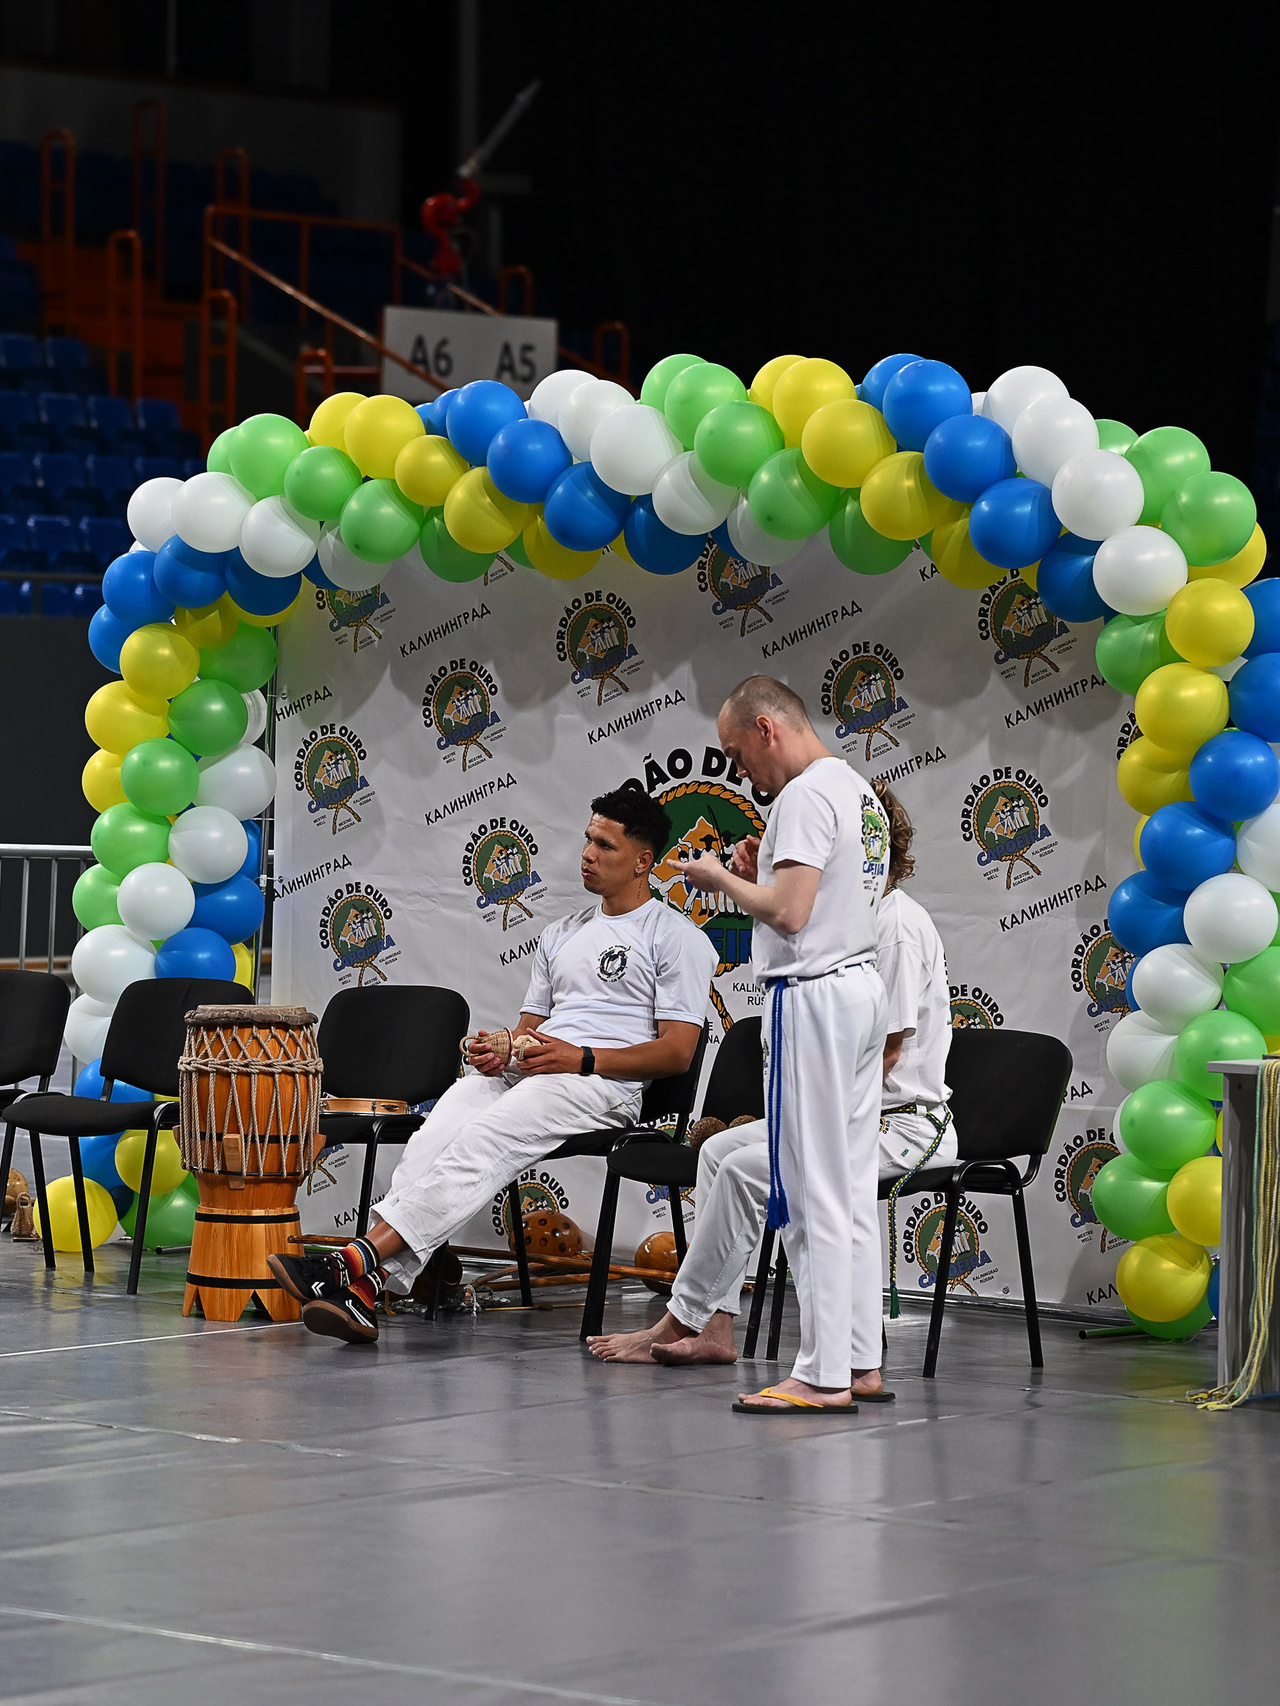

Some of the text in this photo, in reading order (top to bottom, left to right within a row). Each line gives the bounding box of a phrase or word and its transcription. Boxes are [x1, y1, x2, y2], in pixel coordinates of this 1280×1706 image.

[584, 590, 602, 602] DE
[606, 592, 636, 628] OURO
[400, 602, 491, 658] КАЛИНИНГРАД
[762, 600, 862, 659] КАЛИНИНГРАД
[450, 658, 466, 672] DE
[469, 660, 498, 696] OURO
[852, 641, 870, 654] DE
[874, 643, 904, 681] OURO
[436, 710, 501, 750] CAPOEIRA
[587, 689, 686, 745] КАЛИНИНГРАД
[835, 696, 909, 738] CAPOEIRA
[320, 724, 336, 734] DE
[339, 726, 367, 760] OURO
[308, 776, 370, 813] CAPOEIRA
[425, 772, 517, 826] КАЛИНИНГРАД
[993, 766, 1012, 780] DE
[1015, 768, 1048, 808] OURO
[490, 816, 506, 830] DE
[509, 820, 538, 856] OURO
[976, 824, 1052, 866] CAPOEIRA
[346, 882, 361, 894] DE
[364, 884, 392, 920] OURO
[476, 870, 542, 909] CAPOEIRA
[1000, 874, 1107, 932] КАЛИНИНГРАД
[333, 934, 396, 972] CAPOEIRA
[950, 984, 1004, 1026] DE OURO
[1086, 1128, 1106, 1142] DE
[540, 1172, 570, 1210] OURO
[918, 1250, 992, 1288] CAOEIRA
